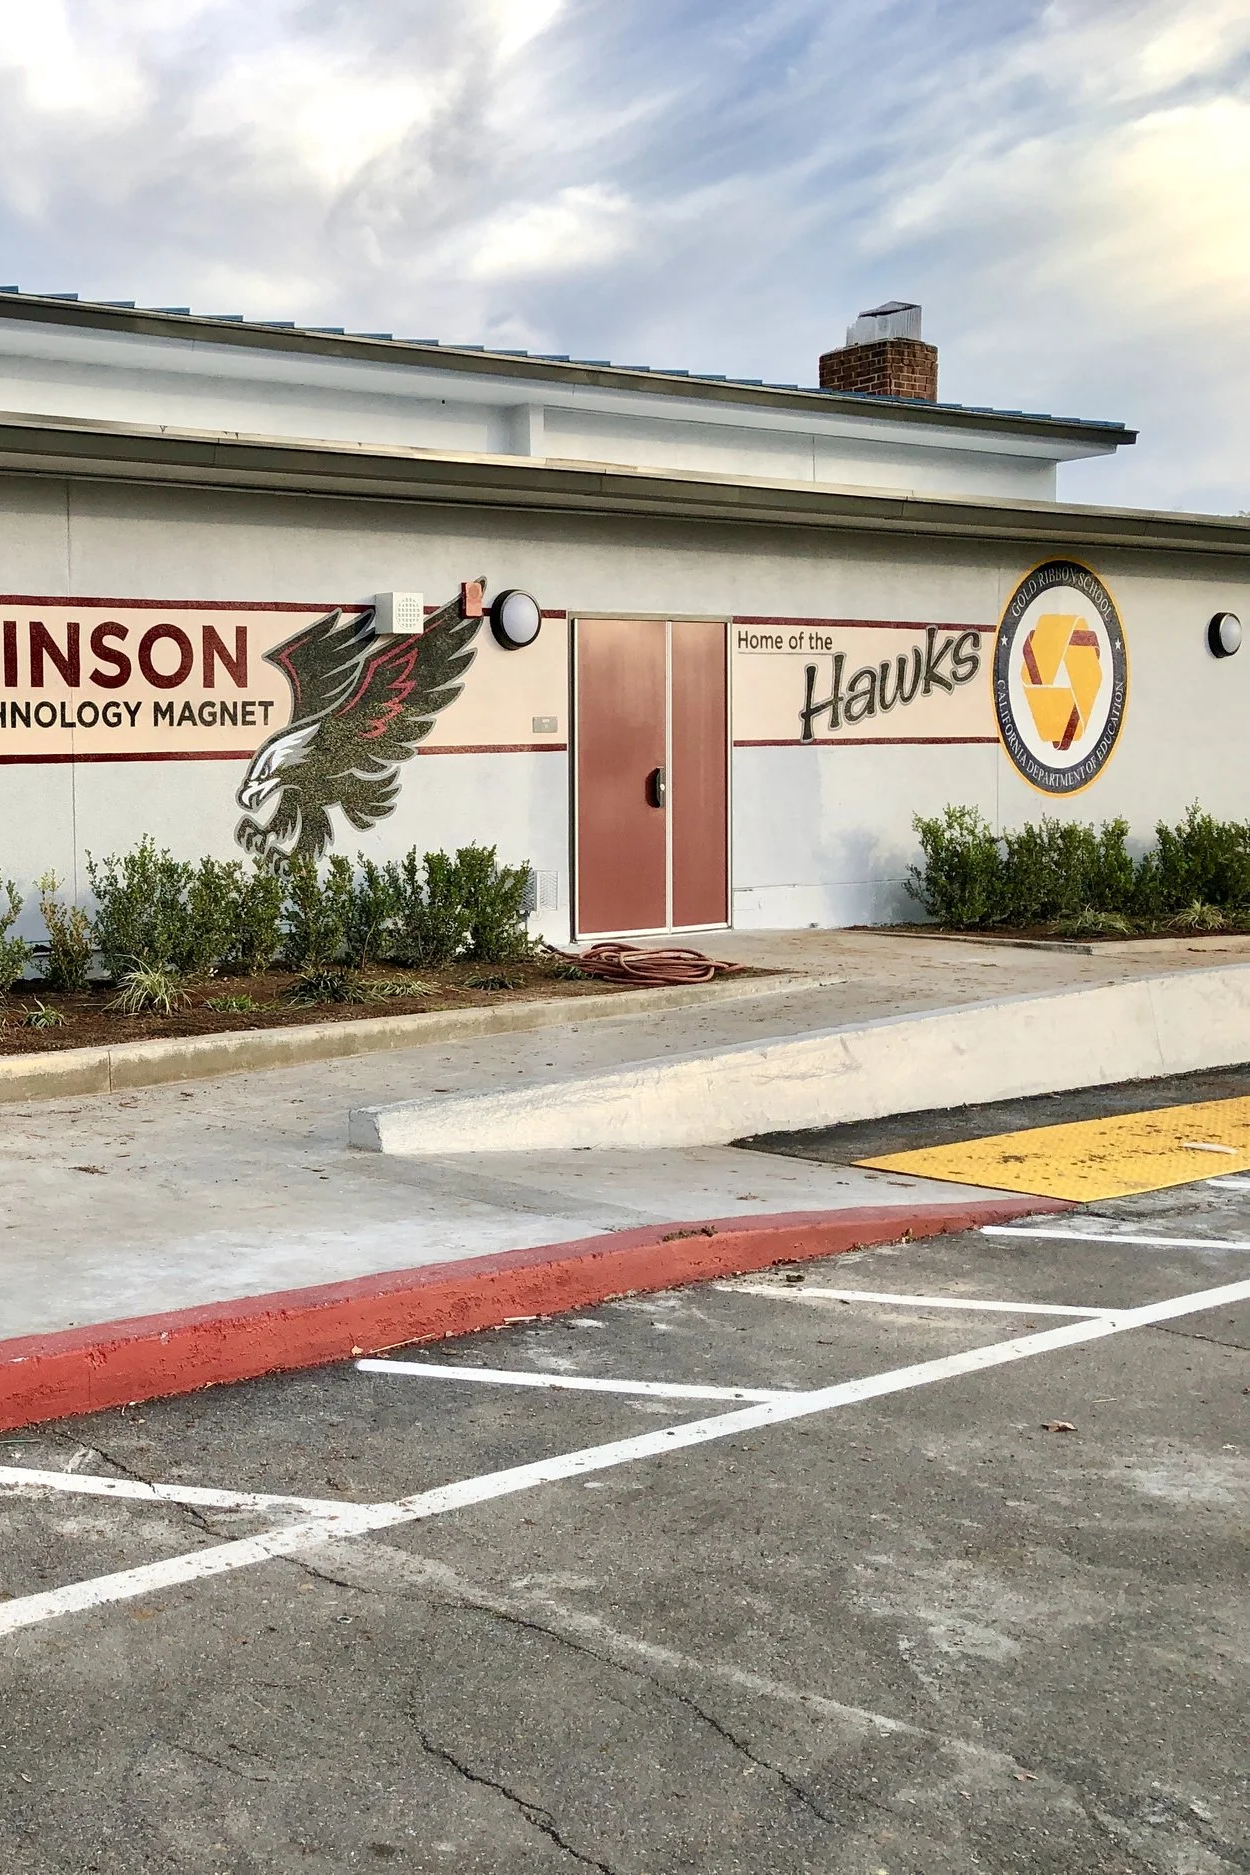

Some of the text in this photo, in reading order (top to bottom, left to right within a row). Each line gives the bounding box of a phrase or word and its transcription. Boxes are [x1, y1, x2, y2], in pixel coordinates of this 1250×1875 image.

[1011, 567, 1112, 621] GOLD RIBBON SCHOOL
[738, 631, 833, 650] Home of the
[799, 624, 981, 742] Hawks
[153, 700, 274, 727] MAGNET
[997, 680, 1124, 787] CALIFORNIA DEPARTMENT OF EDUCATION
